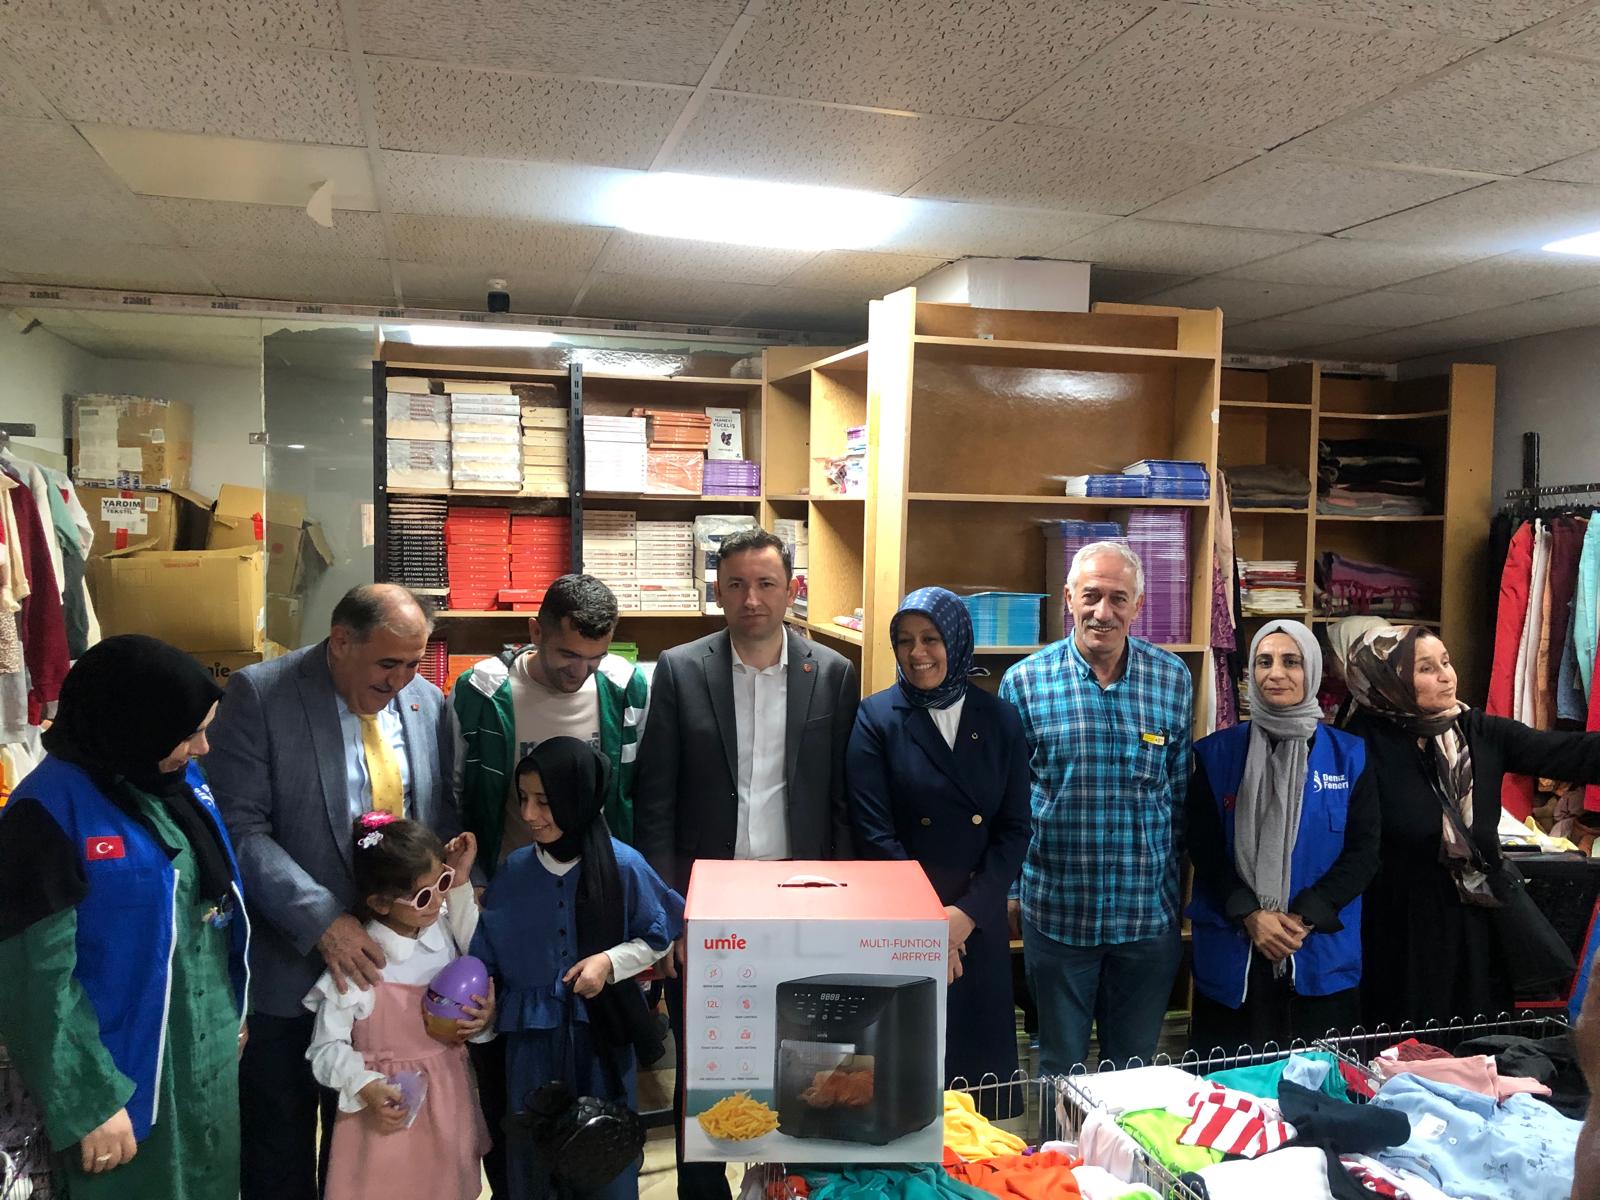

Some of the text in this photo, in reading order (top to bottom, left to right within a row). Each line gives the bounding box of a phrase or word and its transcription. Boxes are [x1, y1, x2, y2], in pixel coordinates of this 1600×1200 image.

[103, 500, 140, 508] YARDIM
[704, 934, 941, 949] umie MULTI-FUNTION
[891, 952, 941, 962] AIRFRYER
[706, 1000, 720, 1008] 12L
